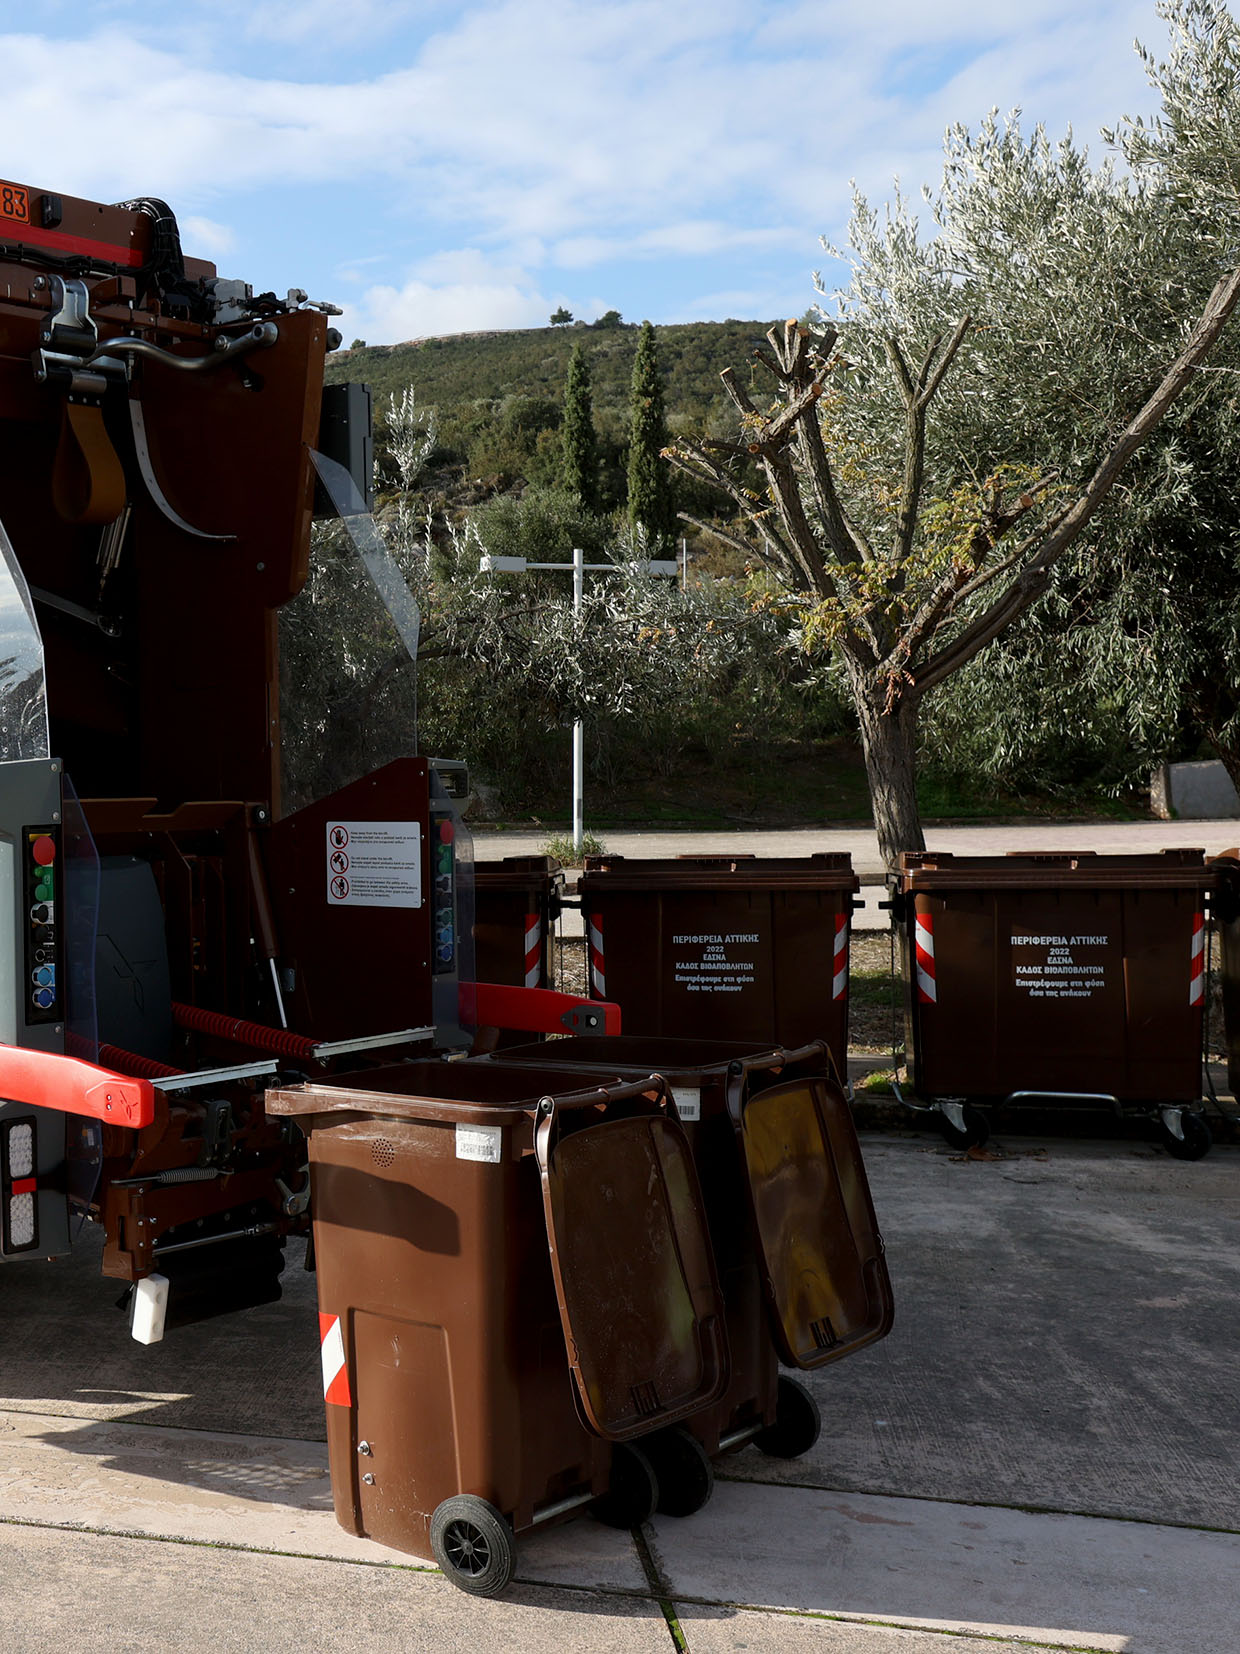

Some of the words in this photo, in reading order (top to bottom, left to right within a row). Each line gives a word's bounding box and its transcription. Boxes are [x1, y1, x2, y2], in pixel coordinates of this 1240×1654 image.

[672, 935, 723, 944] ΠΕΡΙΦΕΡΕΙΑ
[725, 935, 759, 943] ΑΤΤΙΚΗΣ
[1010, 936, 1068, 945] ΠΕΡΙΦΕΡΕΙΑ
[1069, 936, 1108, 945] ΑΤΤΙΚΗΣ
[675, 962, 699, 970] ΚΑΔΟΣ
[700, 962, 754, 970] ΒΙΟΑΠΟΒΛΗΤΩΝ
[1016, 966, 1042, 974] ΚΑΔΟΣ
[1044, 966, 1104, 974] ΒΙΟΑΠΟΒΛΗΤΩΝ
[675, 974, 722, 984] Επιστρέφουμε
[736, 974, 755, 984] φύση
[1015, 978, 1068, 988] Επιστρέφουμε
[1084, 979, 1105, 988] φύση
[687, 983, 700, 991] όσα
[701, 984, 713, 992] της
[713, 984, 743, 992] ανήκουν
[1029, 988, 1044, 997] όσα
[1045, 989, 1059, 998] της
[1060, 988, 1091, 996] ανήκουν
